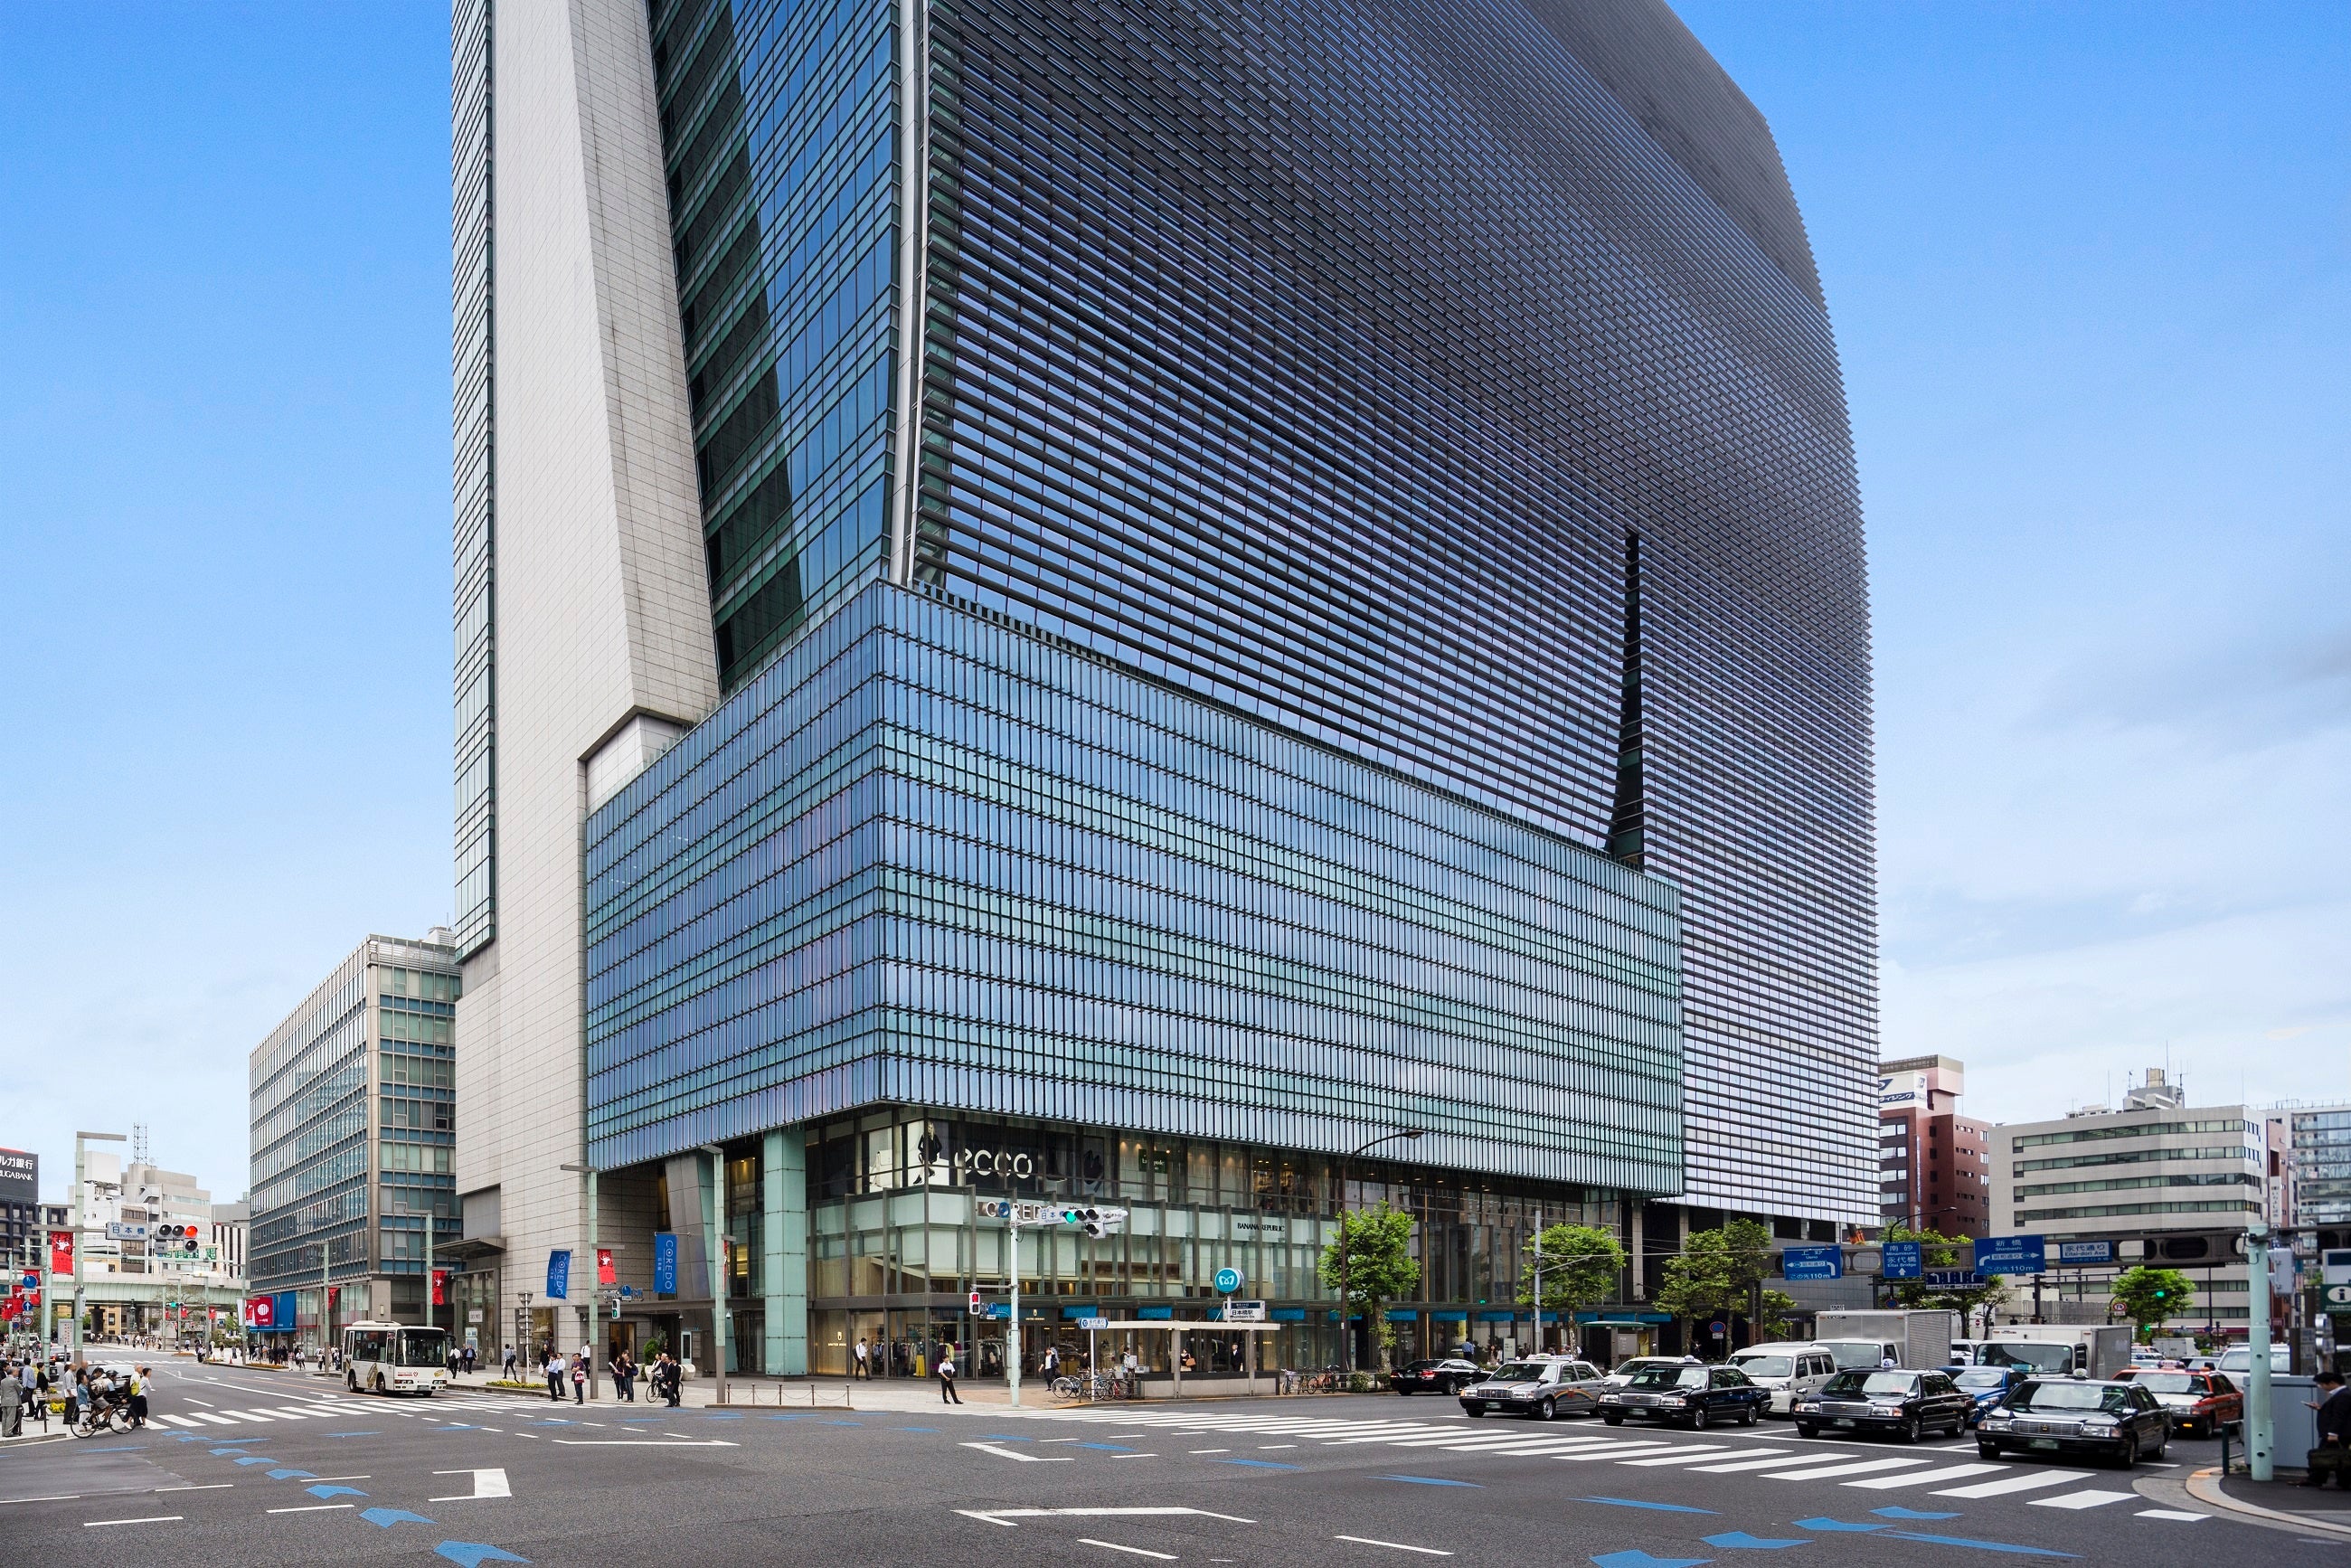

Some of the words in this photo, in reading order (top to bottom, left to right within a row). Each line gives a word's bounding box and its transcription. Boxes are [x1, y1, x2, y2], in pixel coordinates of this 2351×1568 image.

[954, 1148, 1032, 1178] ecco
[113, 1226, 145, 1234] 日本橋
[2066, 1243, 2105, 1252] 永代通り
[556, 1253, 566, 1295] COREDO
